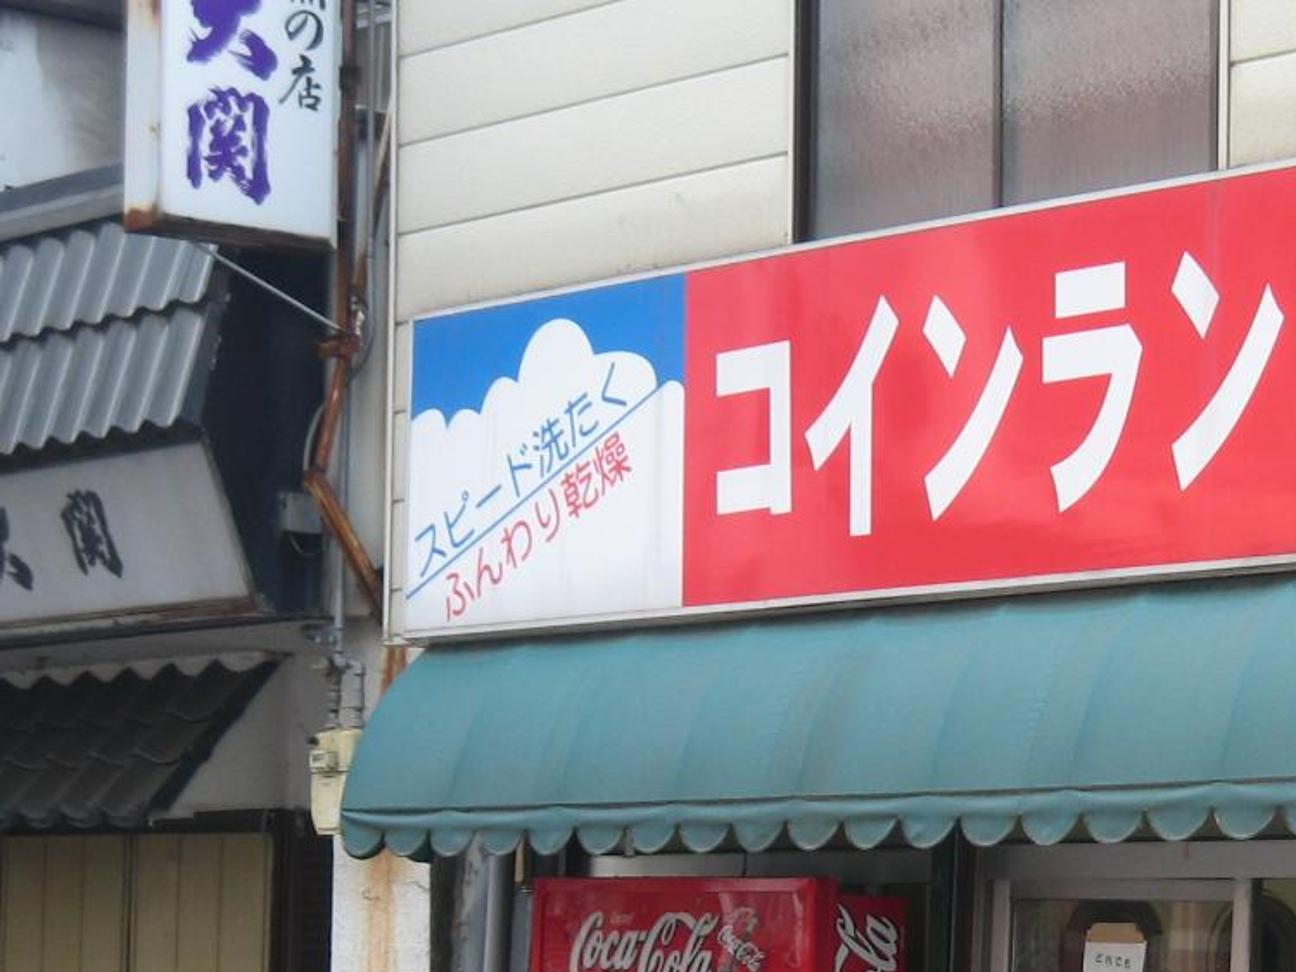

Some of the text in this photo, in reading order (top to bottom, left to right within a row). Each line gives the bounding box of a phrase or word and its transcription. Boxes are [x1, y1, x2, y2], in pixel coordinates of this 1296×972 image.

[278, 0, 327, 112] の店
[414, 361, 628, 578] スピード洗たく
[444, 432, 632, 622] ふんわり乾燥
